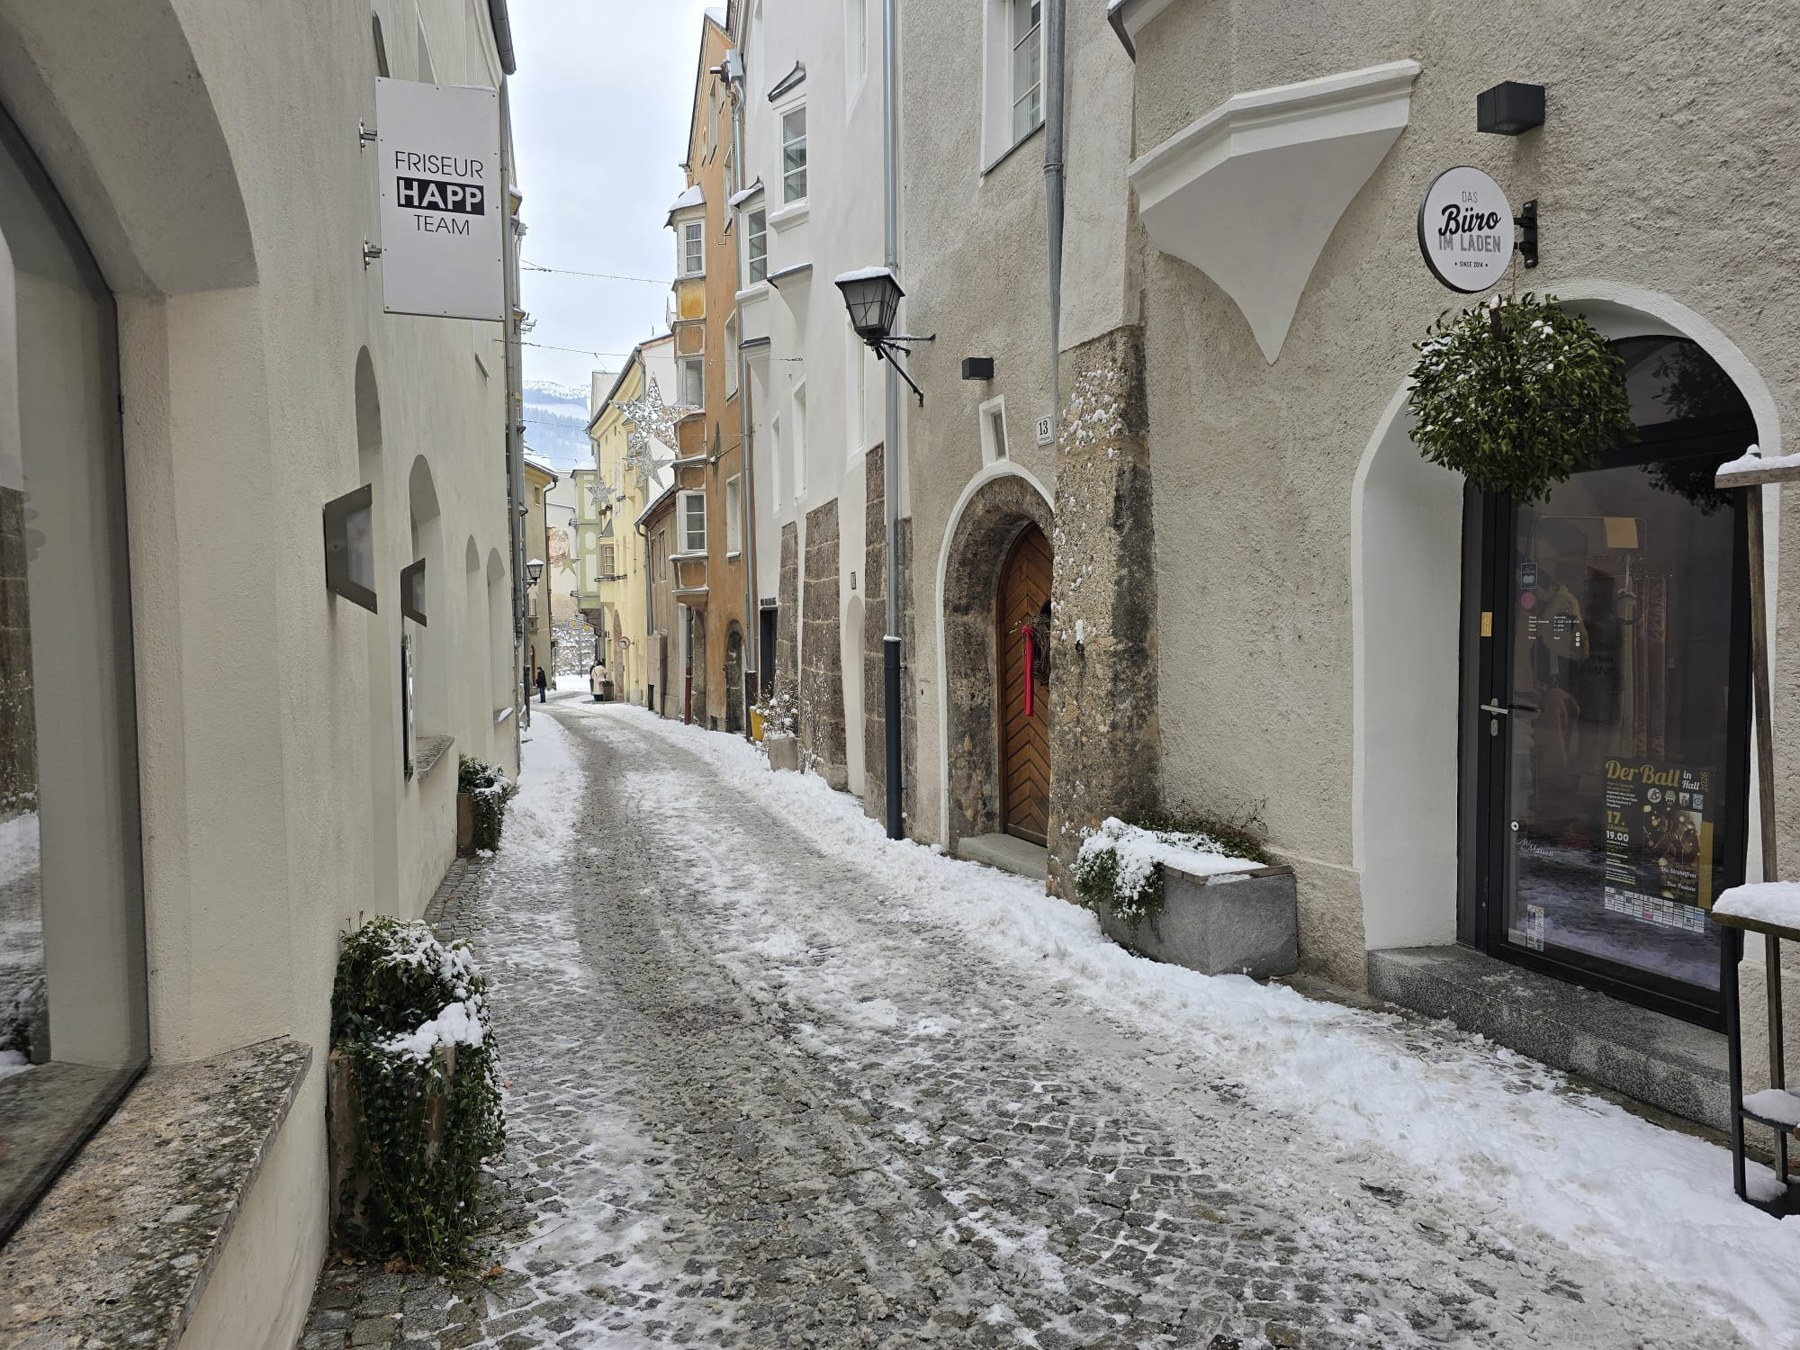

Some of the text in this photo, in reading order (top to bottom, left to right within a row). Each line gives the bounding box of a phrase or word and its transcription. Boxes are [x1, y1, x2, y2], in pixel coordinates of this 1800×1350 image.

[395, 150, 483, 179] FRISEUR
[398, 178, 483, 213] HAPP
[1461, 190, 1478, 203] DAS
[413, 214, 470, 236] TEAM
[1438, 203, 1501, 236] Büro
[1439, 234, 1501, 253] IM LADEN
[1459, 260, 1473, 268] SINCE
[1038, 419, 1049, 436] 13
[1605, 760, 1639, 781] Der
[1640, 764, 1681, 788] Ball
[1683, 770, 1692, 780] in
[1700, 770, 1709, 793] 2026
[1681, 779, 1700, 791] Hall
[1606, 810, 1625, 826] 17.
[1605, 830, 1629, 842] 19.00
